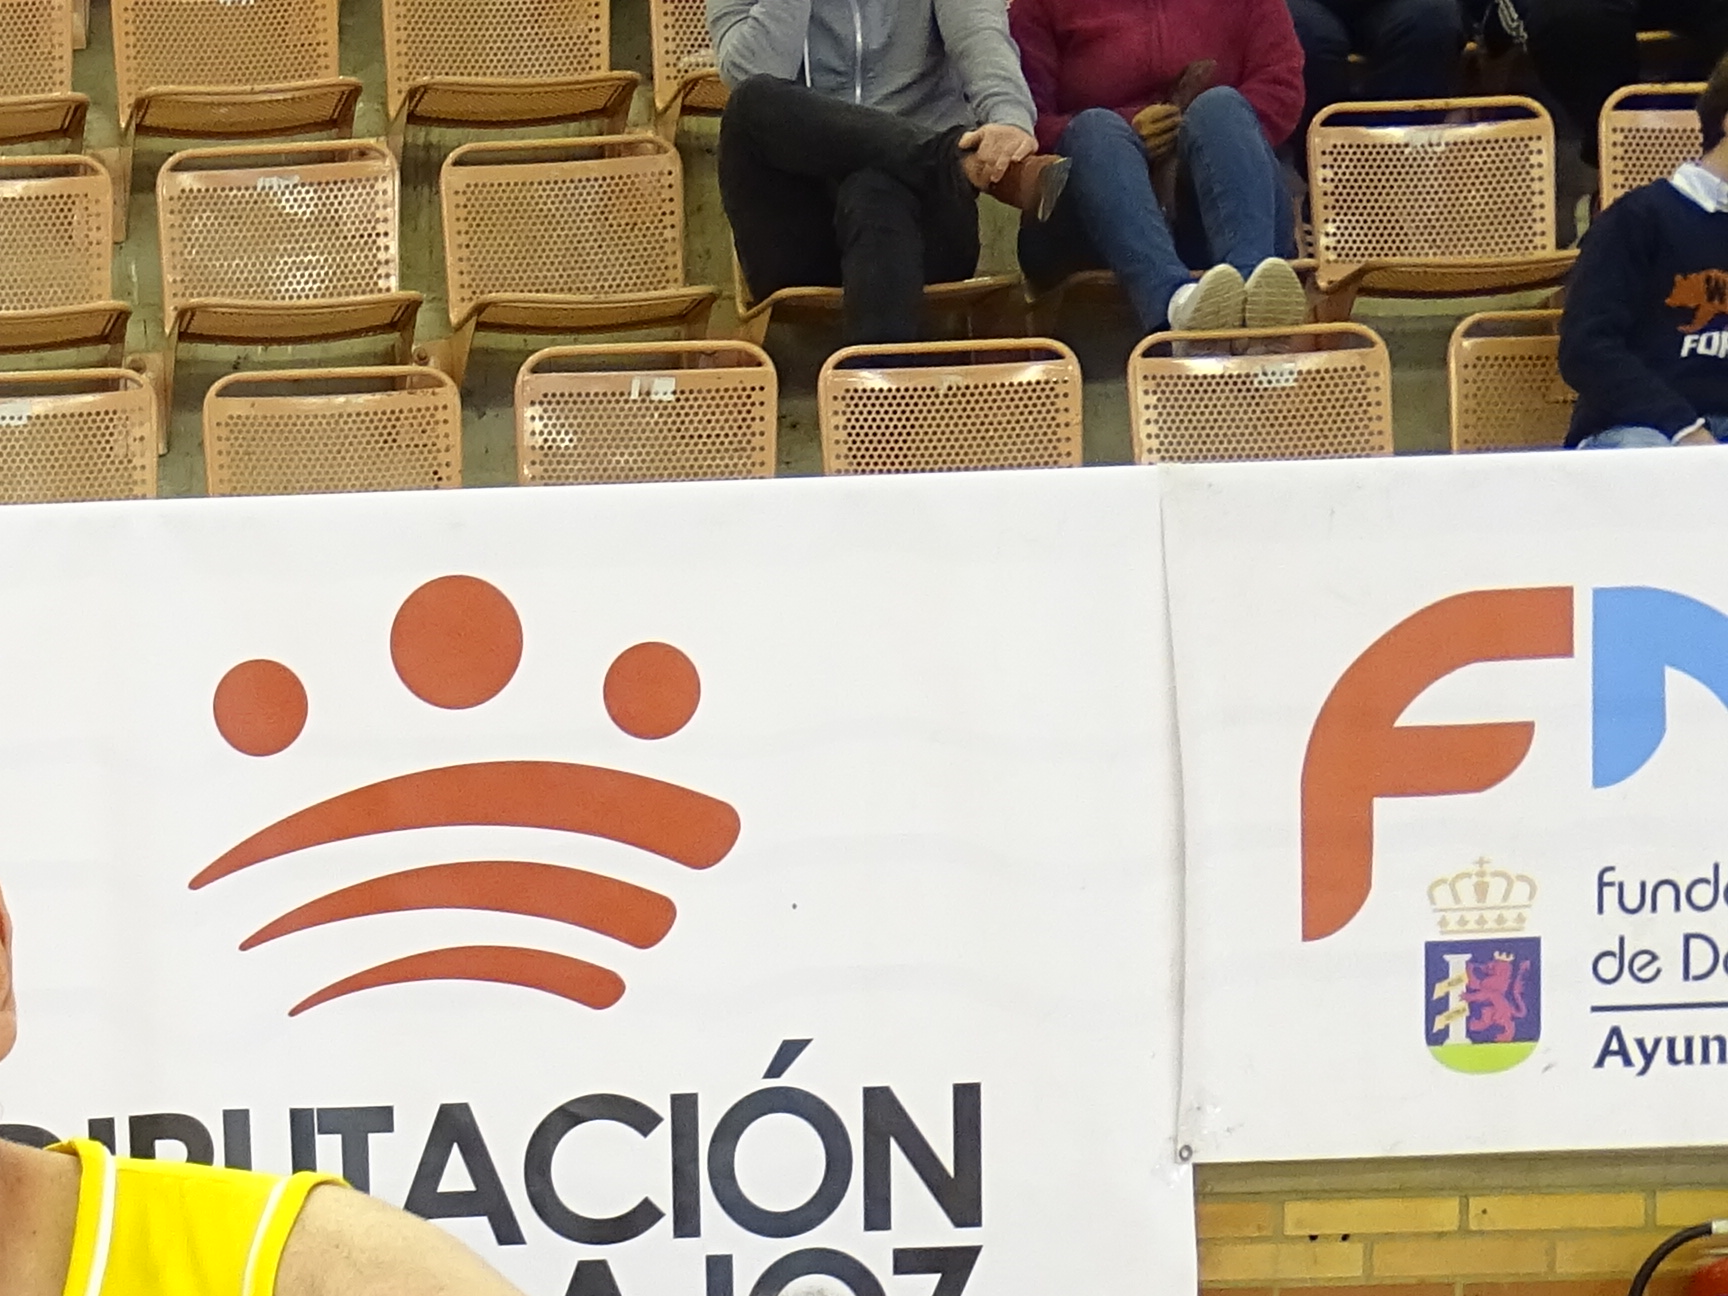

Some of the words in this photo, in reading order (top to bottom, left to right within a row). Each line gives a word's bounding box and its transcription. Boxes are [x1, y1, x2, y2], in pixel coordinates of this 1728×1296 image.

[1597, 862, 1728, 915] fund
[1592, 935, 1662, 985] de
[1682, 932, 1728, 981] D
